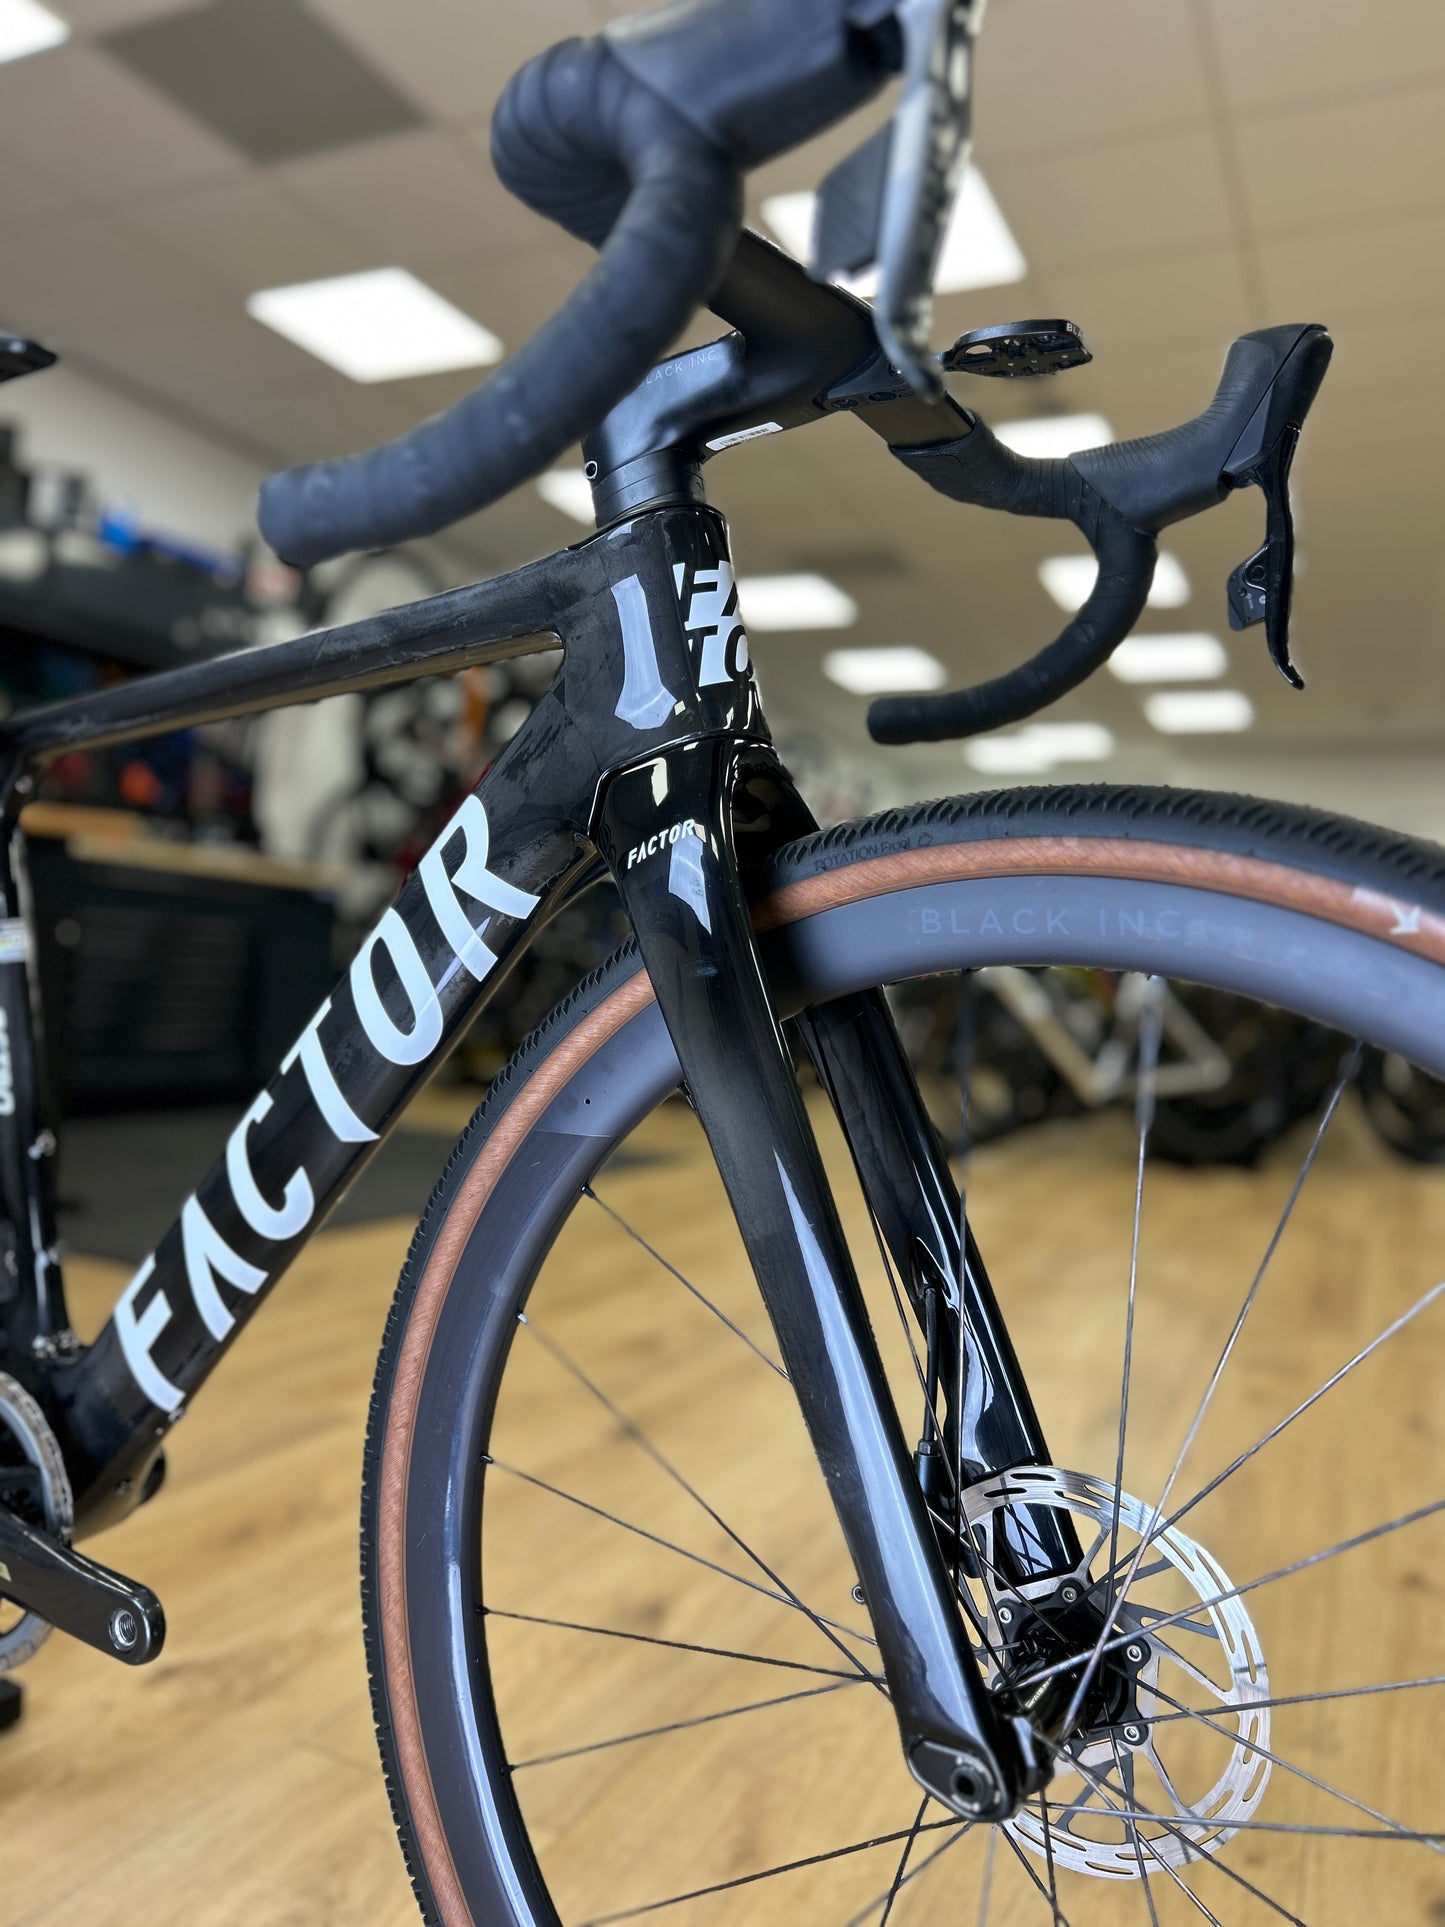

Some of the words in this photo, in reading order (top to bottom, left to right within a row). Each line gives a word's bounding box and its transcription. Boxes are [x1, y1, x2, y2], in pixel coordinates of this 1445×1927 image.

[645, 362, 683, 385] LACK
[689, 349, 716, 368] INC
[627, 819, 695, 870] FACTOR
[815, 844, 878, 871] ROTATION
[920, 908, 1070, 935] BLACK
[1100, 908, 1180, 940] INC
[113, 794, 541, 1412] FACTOR
